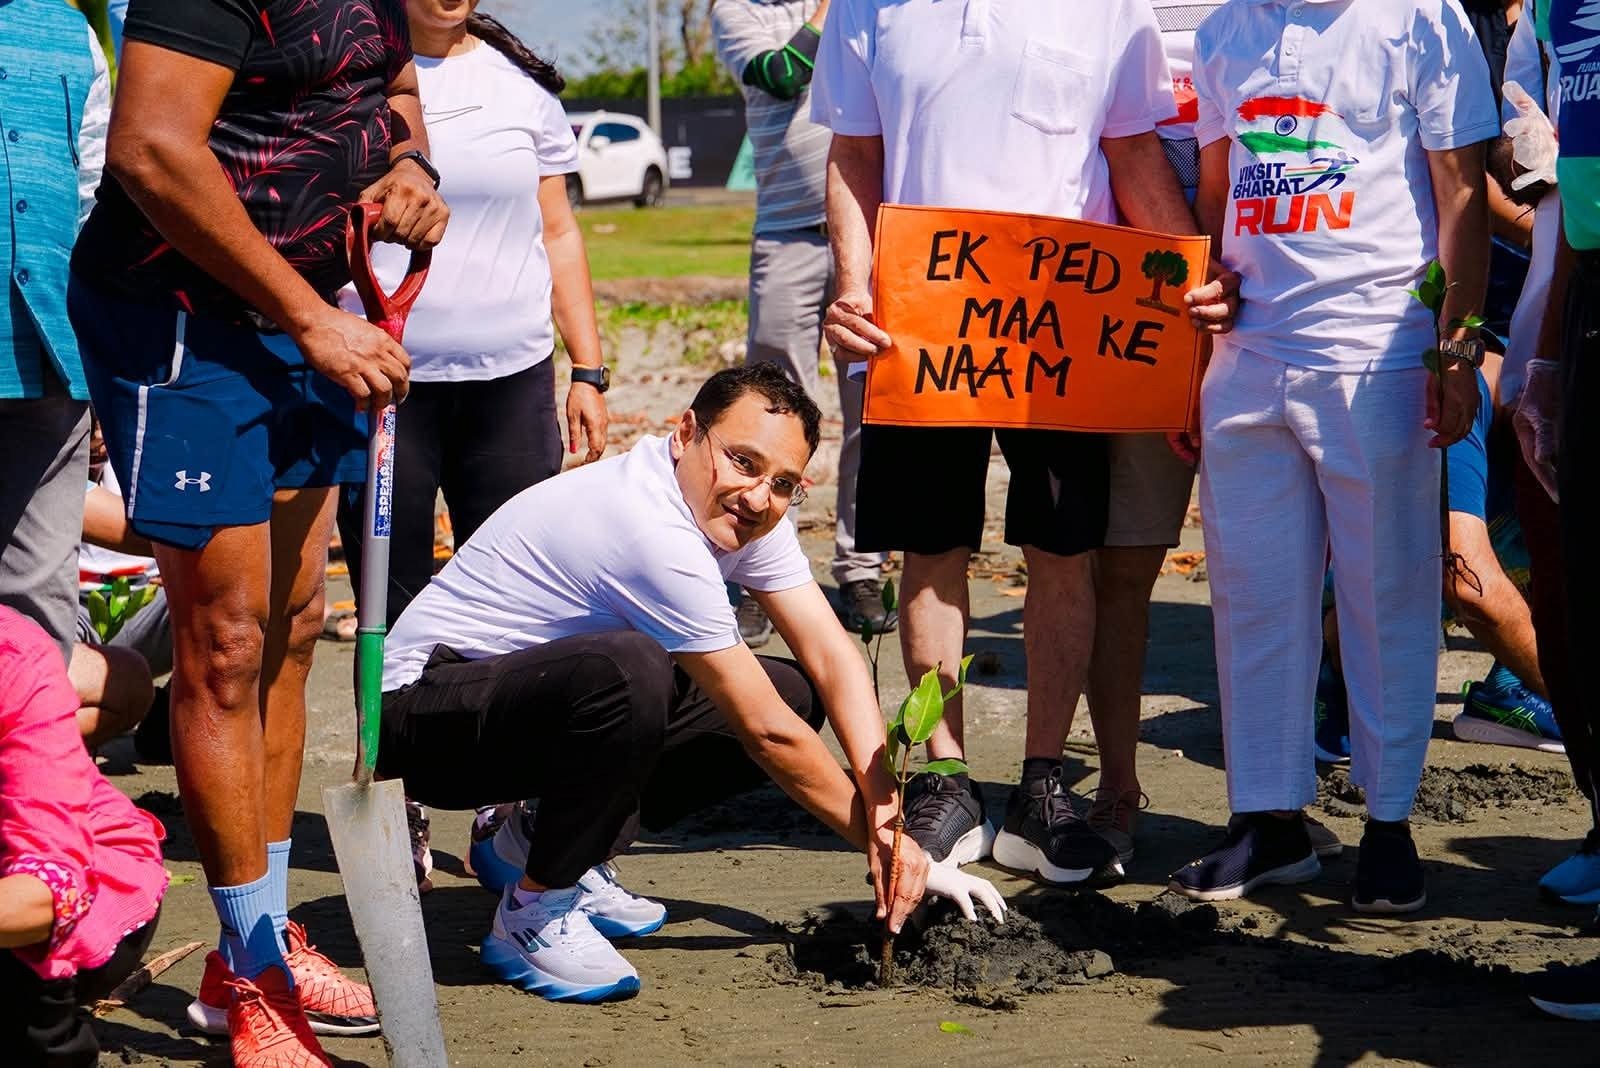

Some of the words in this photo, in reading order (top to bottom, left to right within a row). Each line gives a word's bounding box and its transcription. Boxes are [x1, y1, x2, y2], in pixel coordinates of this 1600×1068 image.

[1560, 73, 1600, 103] RUA
[1233, 178, 1304, 199] BHARAT
[1240, 162, 1286, 183] VIKSIT
[1234, 192, 1355, 236] RUN
[927, 229, 991, 284] EK
[1023, 236, 1121, 294] PED
[958, 297, 1064, 349] MAA
[1097, 314, 1165, 366] KE
[914, 344, 1072, 399] NAAM
[379, 466, 391, 516] SPEAR
